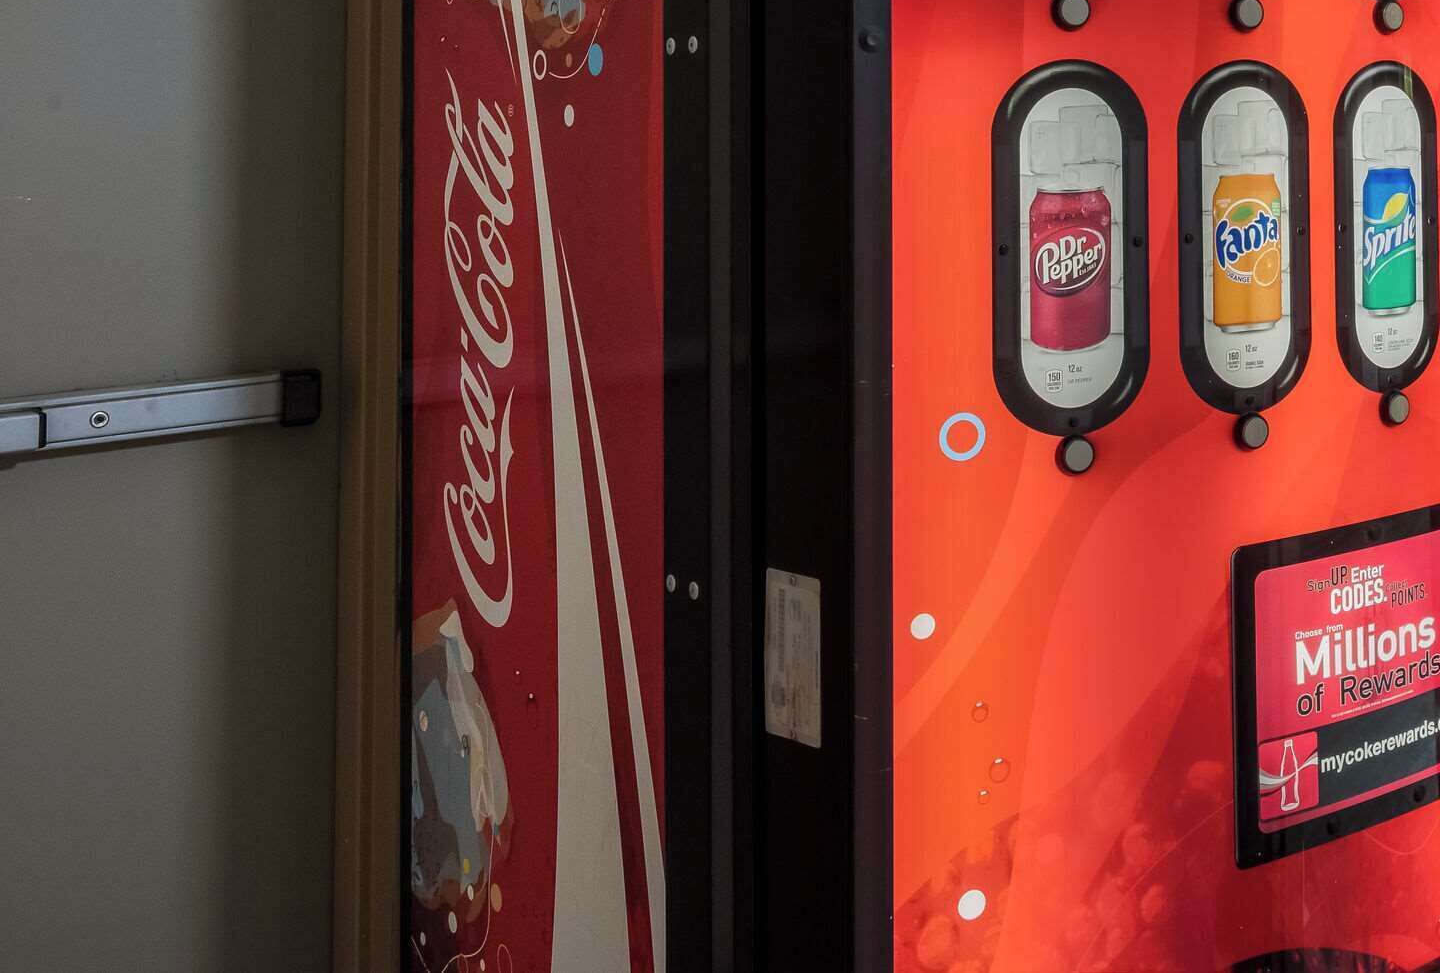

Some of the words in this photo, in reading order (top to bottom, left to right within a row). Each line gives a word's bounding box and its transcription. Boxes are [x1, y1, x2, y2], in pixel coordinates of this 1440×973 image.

[1059, 235, 1087, 261] Dr
[1363, 213, 1416, 270] Sprite
[1037, 241, 1103, 285] Pepper
[444, 67, 516, 628] Coca-Cola
[1245, 344, 1251, 353] 12
[1048, 372, 1061, 382] 150
[1068, 364, 1075, 372] 12
[1307, 580, 1330, 593] Sign
[1351, 564, 1384, 583] Enter
[1330, 578, 1387, 615] CODES.
[1295, 628, 1323, 640] Choose
[1326, 623, 1344, 633] from
[1296, 616, 1436, 685] Millions
[1296, 682, 1325, 716] of
[1339, 650, 1440, 707] Rewards
